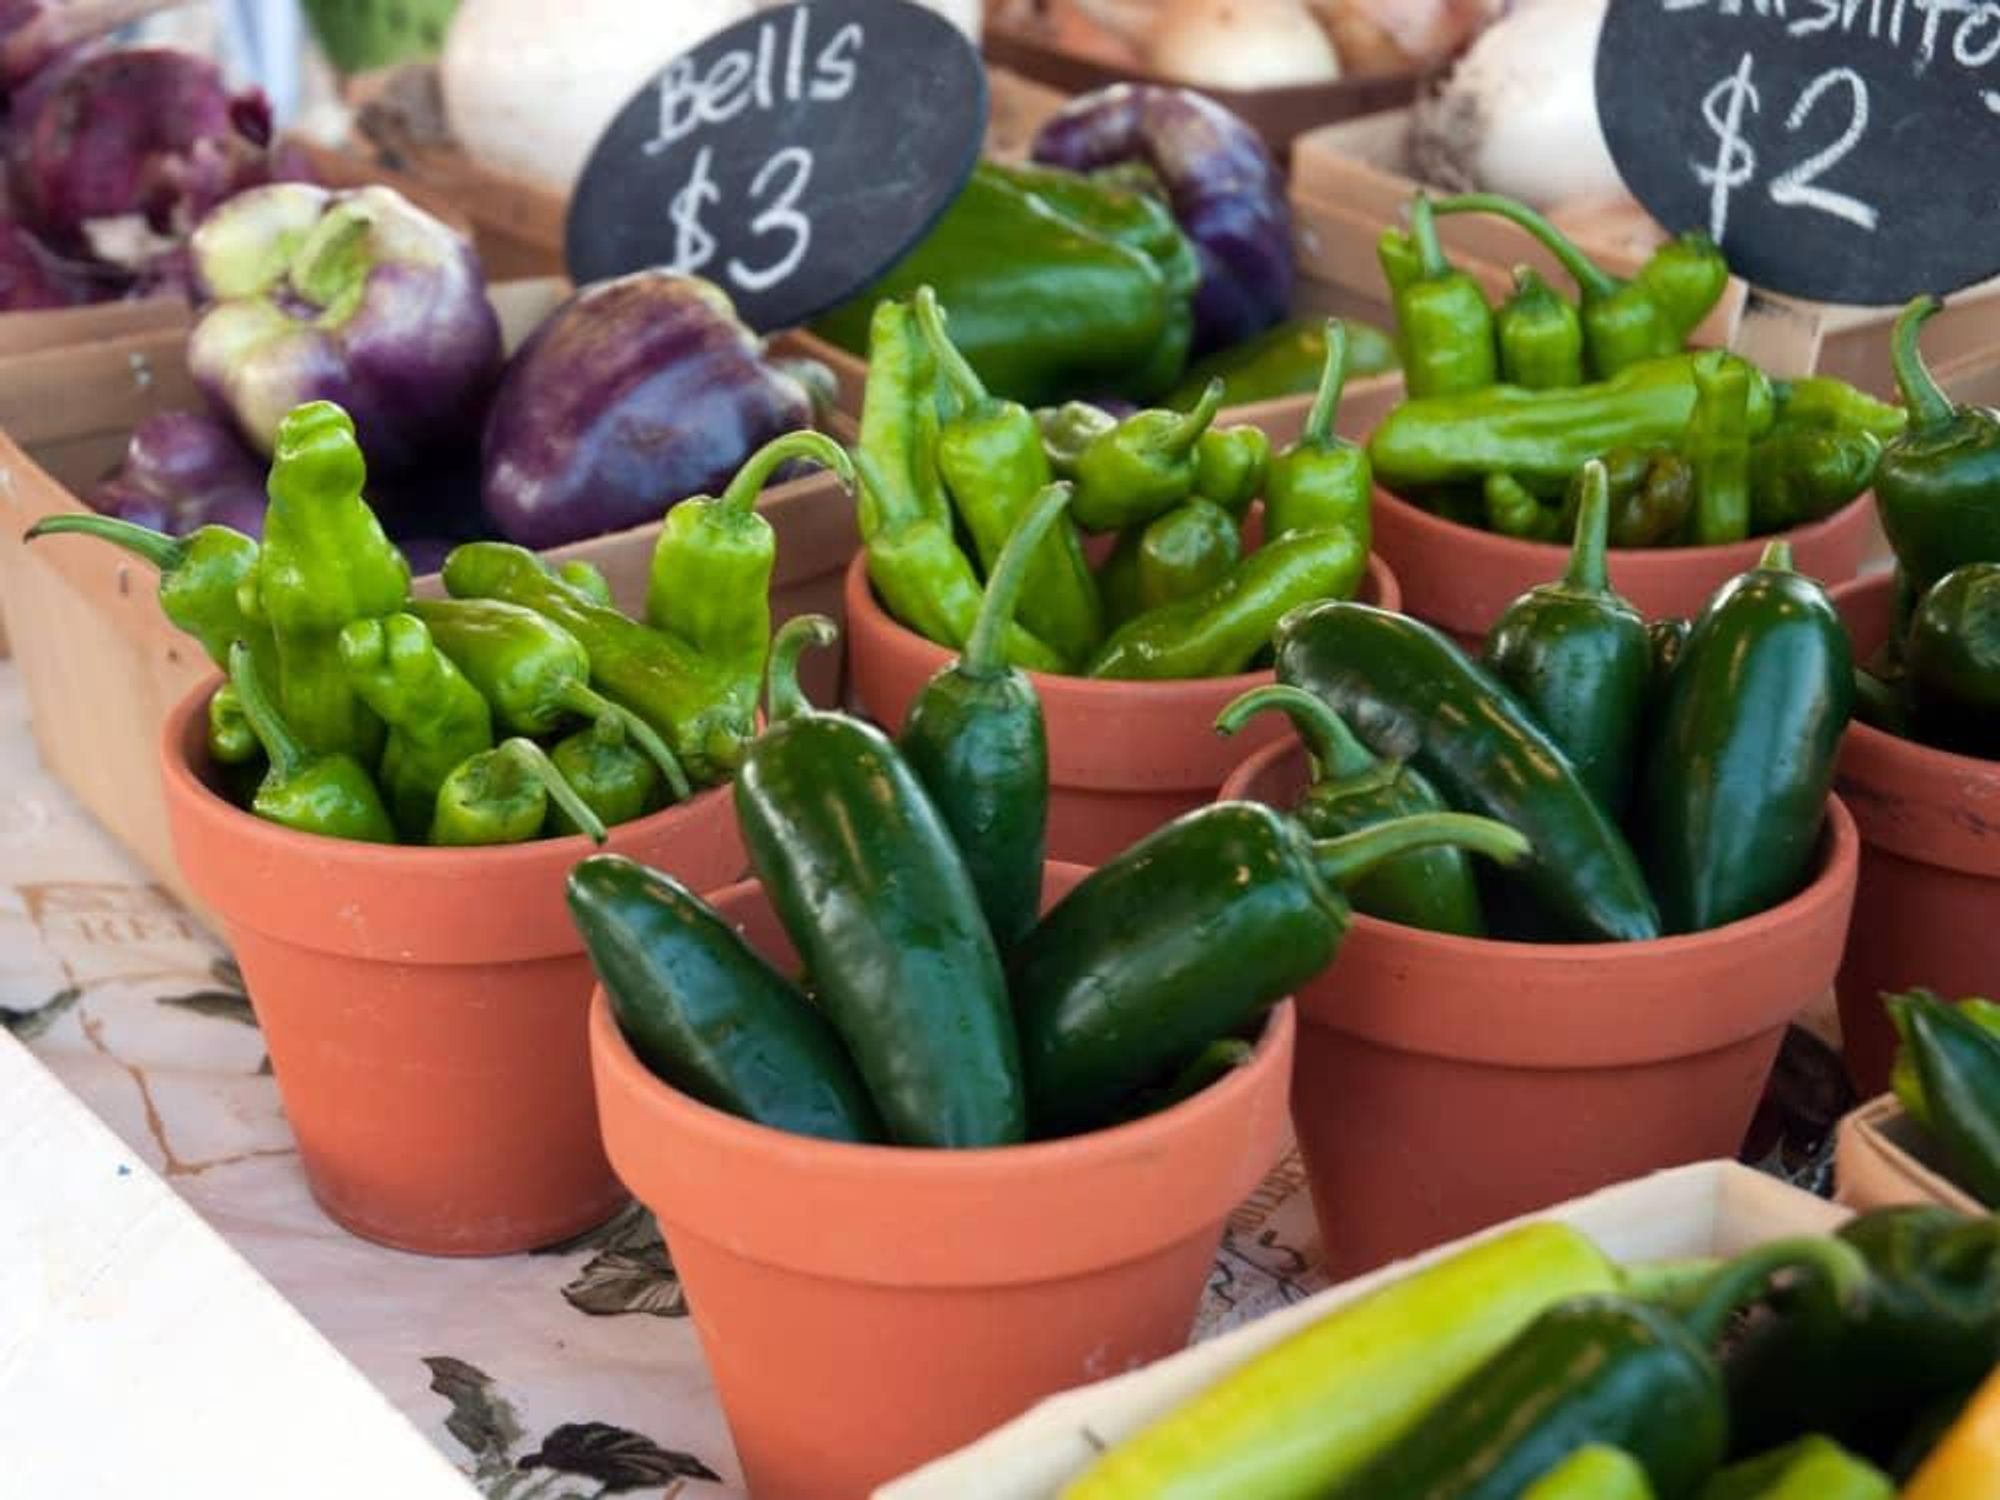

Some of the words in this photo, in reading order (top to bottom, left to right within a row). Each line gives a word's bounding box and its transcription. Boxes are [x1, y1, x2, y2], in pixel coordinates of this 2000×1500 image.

[642, 5, 863, 156] Bells
[1688, 51, 1879, 246] $2
[668, 145, 814, 291] $3
